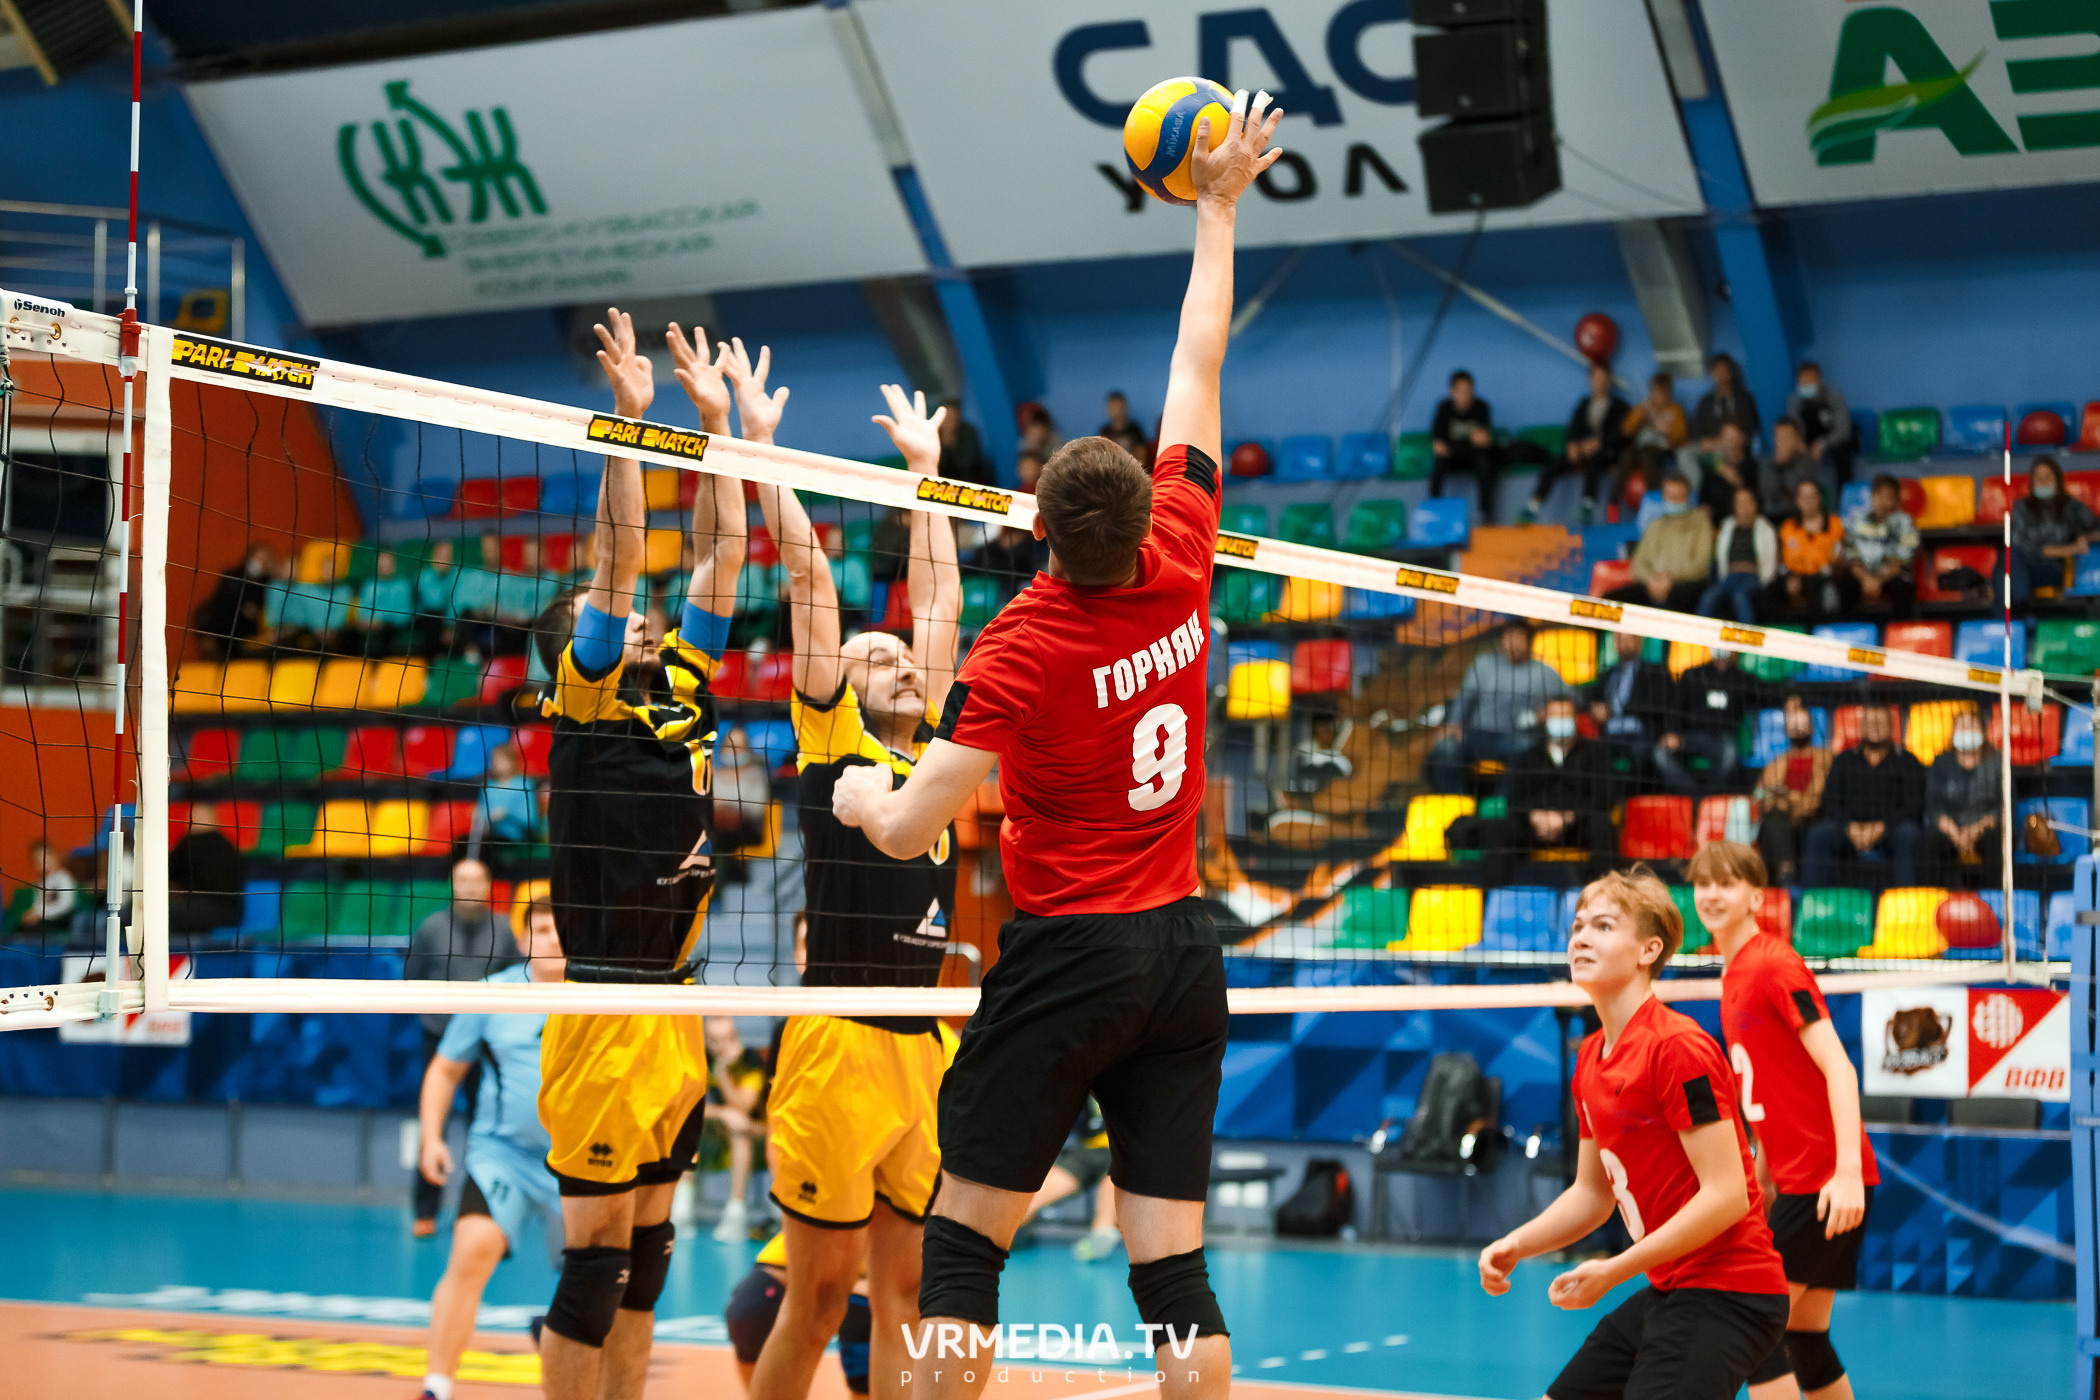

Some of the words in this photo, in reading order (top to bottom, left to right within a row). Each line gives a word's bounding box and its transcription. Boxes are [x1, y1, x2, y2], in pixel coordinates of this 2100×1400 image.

[1052, 0, 1418, 131] СДС
[22, 300, 66, 318] Senoh
[172, 339, 231, 368] PARI
[589, 419, 642, 444] PARI
[641, 428, 707, 456] MATCH
[1092, 608, 1205, 709] ГОРНЯК
[1127, 702, 1189, 812] 9
